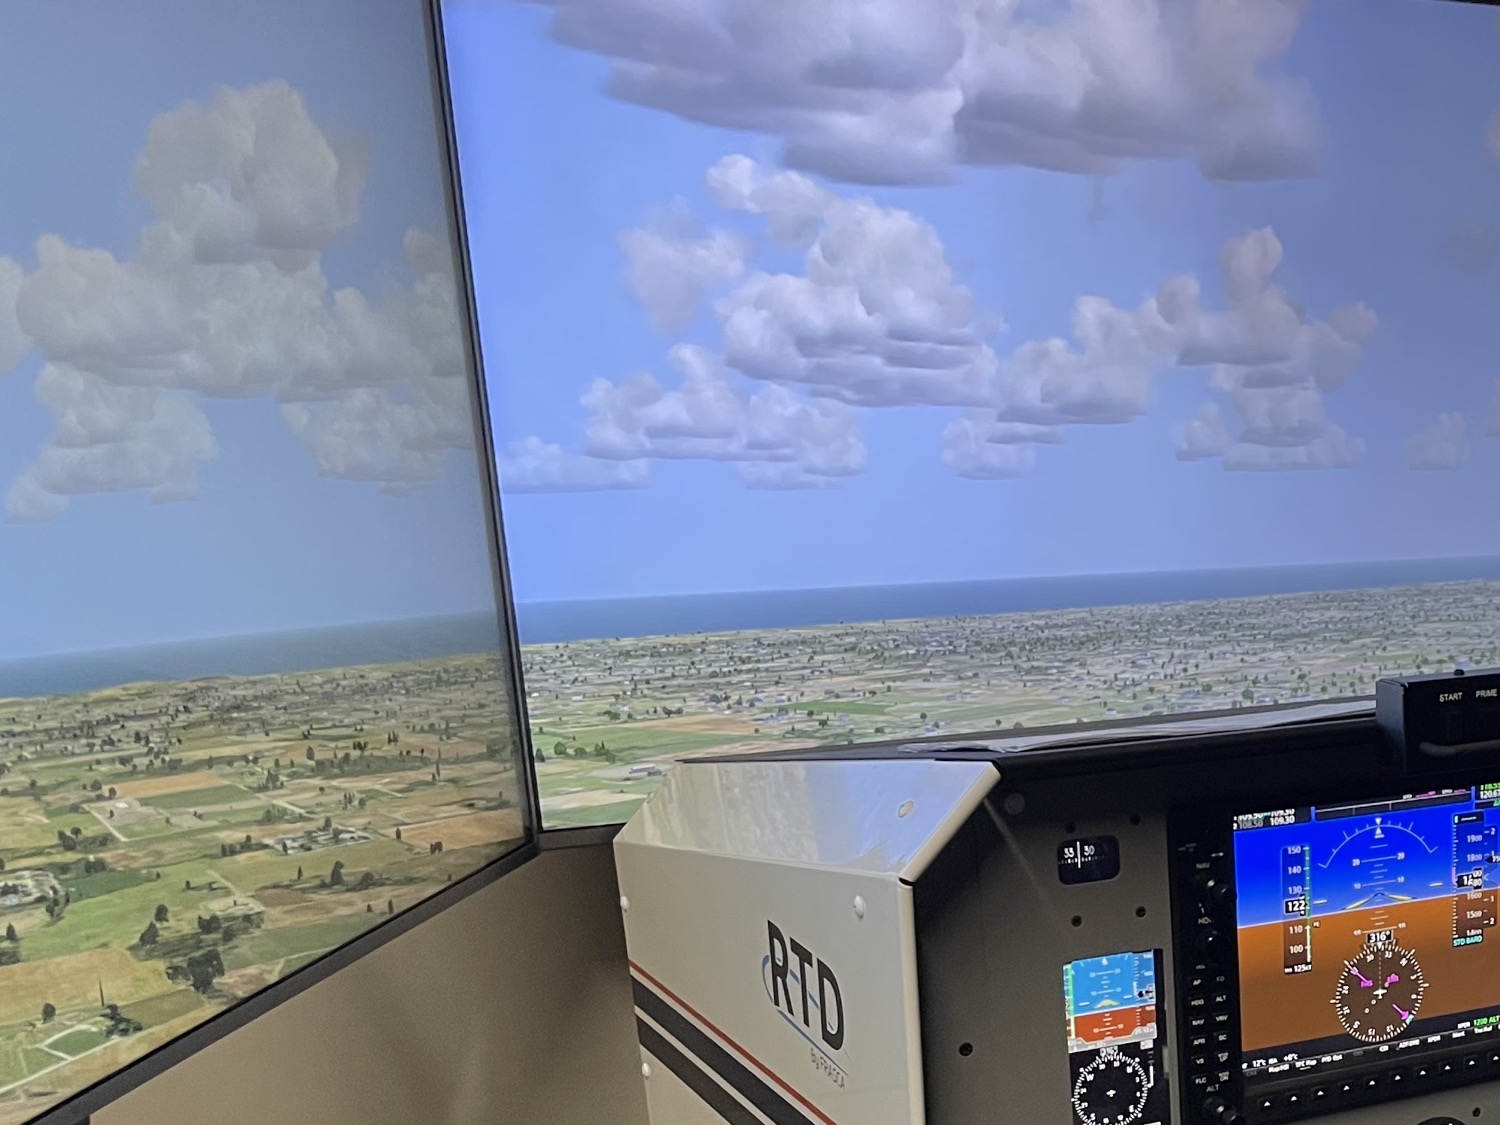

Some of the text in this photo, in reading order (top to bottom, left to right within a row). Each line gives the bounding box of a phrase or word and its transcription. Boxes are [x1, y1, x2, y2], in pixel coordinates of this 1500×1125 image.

[1439, 692, 1463, 702] START
[1475, 689, 1497, 699] PRIME
[1271, 815, 1295, 826] 109.30
[1467, 835, 1483, 843] 1900
[1084, 845, 1095, 856] 30
[1287, 846, 1301, 855] 150
[1467, 854, 1483, 862] 1800
[1288, 866, 1302, 875] 140
[1288, 885, 1302, 894] 130
[1287, 900, 1305, 911] 122
[1466, 911, 1482, 919] 1500
[1289, 925, 1303, 934] 110
[1290, 945, 1304, 954] 100
[767, 919, 845, 1051] RTD
[1473, 1018, 1488, 1026] 1200
[1489, 1015, 1500, 1024] ALT
[1206, 1084, 1219, 1092] ALT
